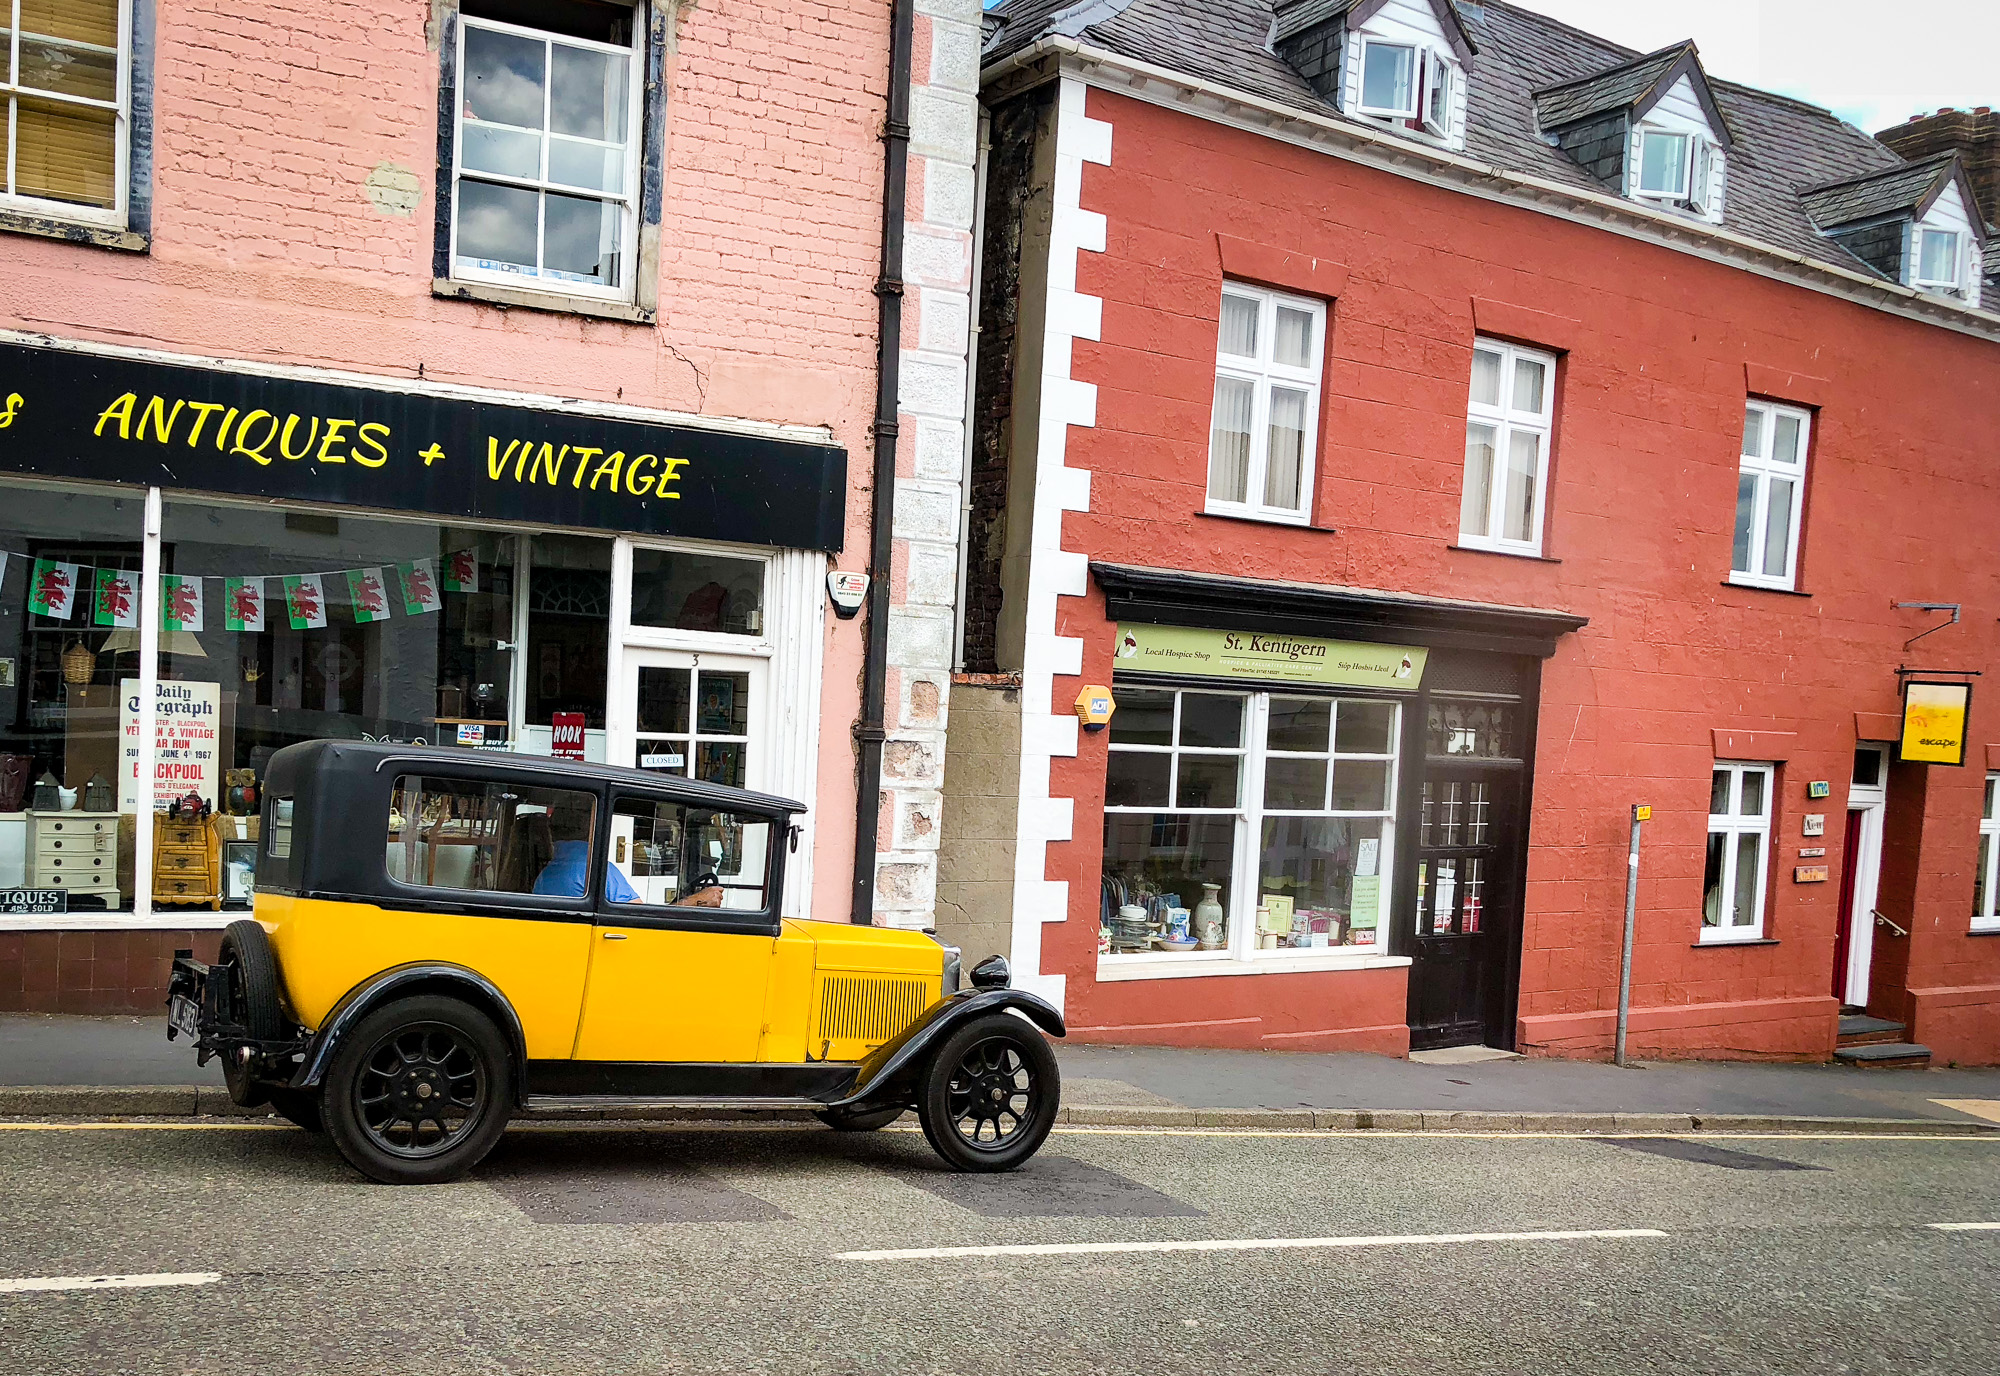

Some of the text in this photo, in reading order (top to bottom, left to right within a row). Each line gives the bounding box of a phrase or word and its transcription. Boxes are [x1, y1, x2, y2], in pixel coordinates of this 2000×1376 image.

[94, 392, 391, 468] ANTIQUES
[488, 436, 690, 499] VINTAGE
[1224, 633, 1327, 660] St. Kentigern
[1145, 647, 1211, 661] Local Hospice Shop
[692, 654, 699, 667] 3
[1092, 701, 1108, 711] ADT
[168, 728, 175, 737] &
[180, 728, 214, 739] VINTAGE
[553, 725, 582, 744] HOOK
[156, 739, 190, 749] AR RUN
[1918, 739, 1958, 748] escape
[161, 750, 179, 758] JUNE
[195, 751, 212, 759] 1967
[1360, 843, 1377, 852] SALE
